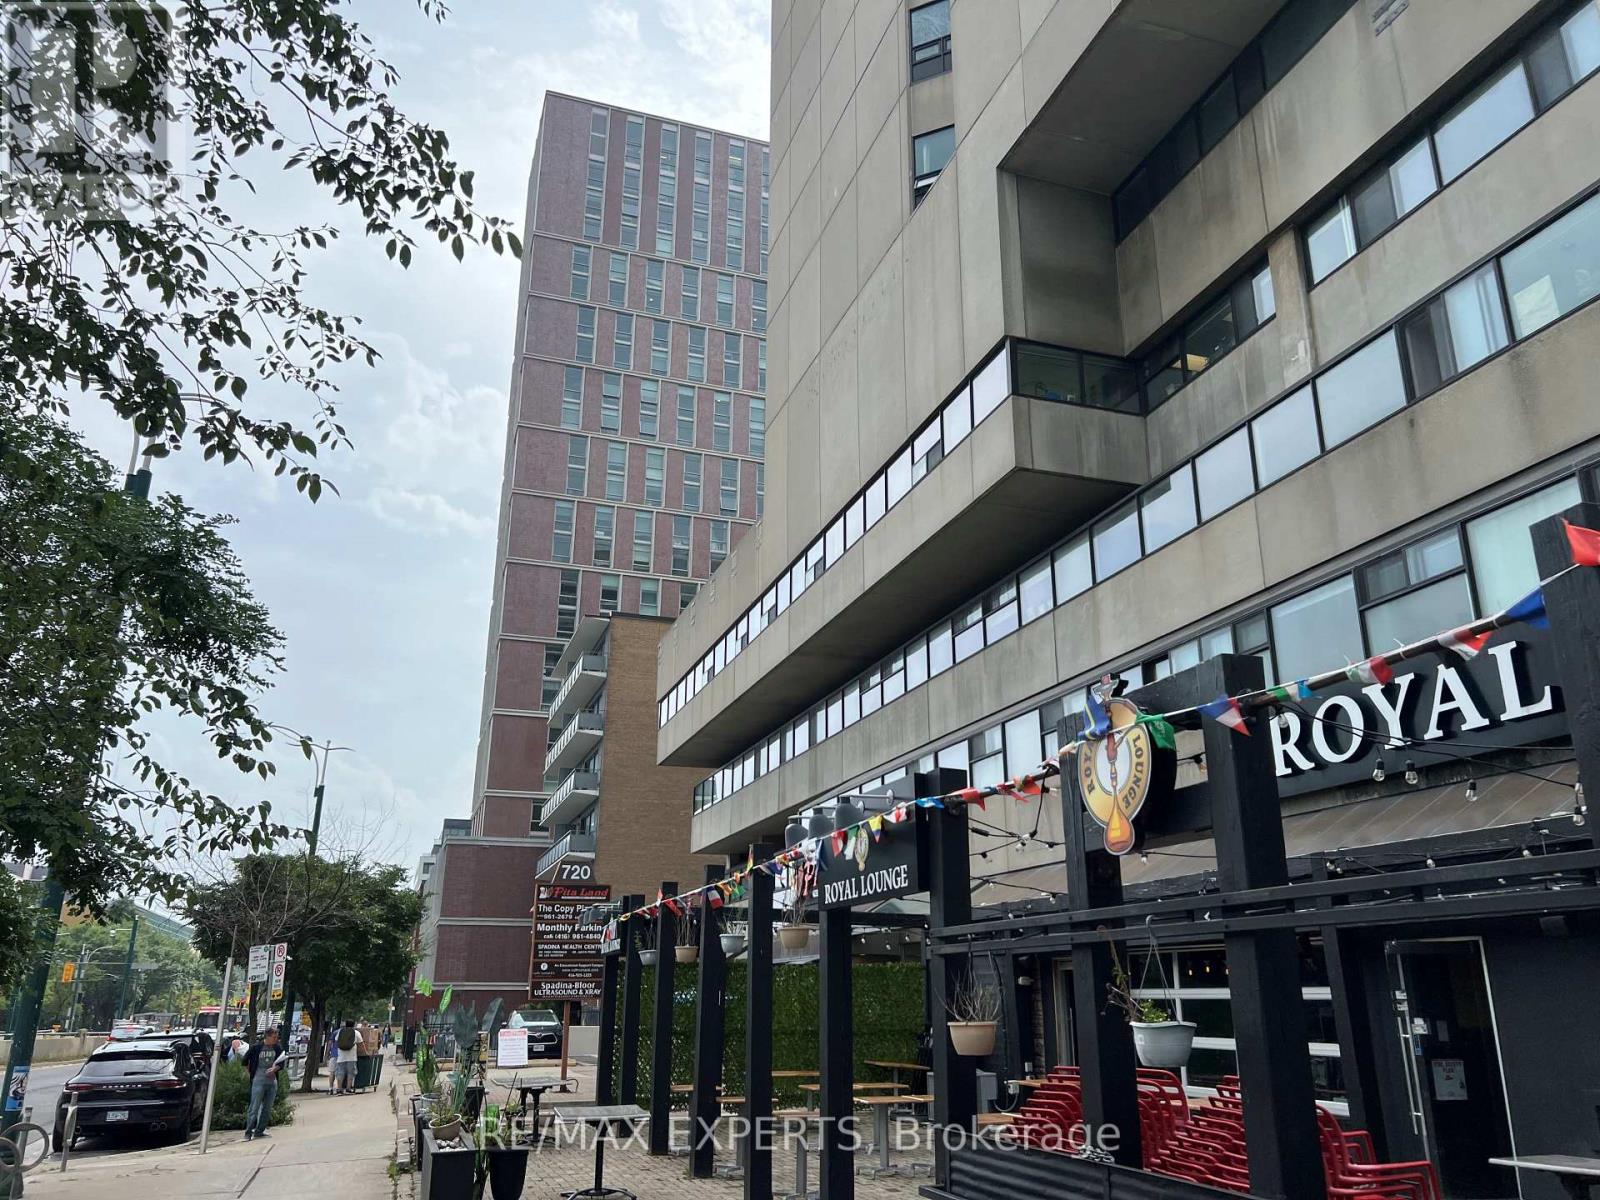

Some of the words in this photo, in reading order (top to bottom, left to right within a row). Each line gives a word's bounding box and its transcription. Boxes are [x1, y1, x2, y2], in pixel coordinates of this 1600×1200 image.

[1269, 640, 1553, 777] ROYAL
[1121, 734, 1145, 810] LOUNGE
[561, 864, 591, 880] 720
[553, 886, 577, 898] Pita
[580, 888, 609, 897] Land
[824, 878, 859, 905] ROYAL
[860, 864, 909, 897] LOUNGE
[537, 904, 553, 912] The
[554, 904, 575, 914] Copy
[536, 923, 573, 933] Monthly
[574, 923, 602, 932] Parkin
